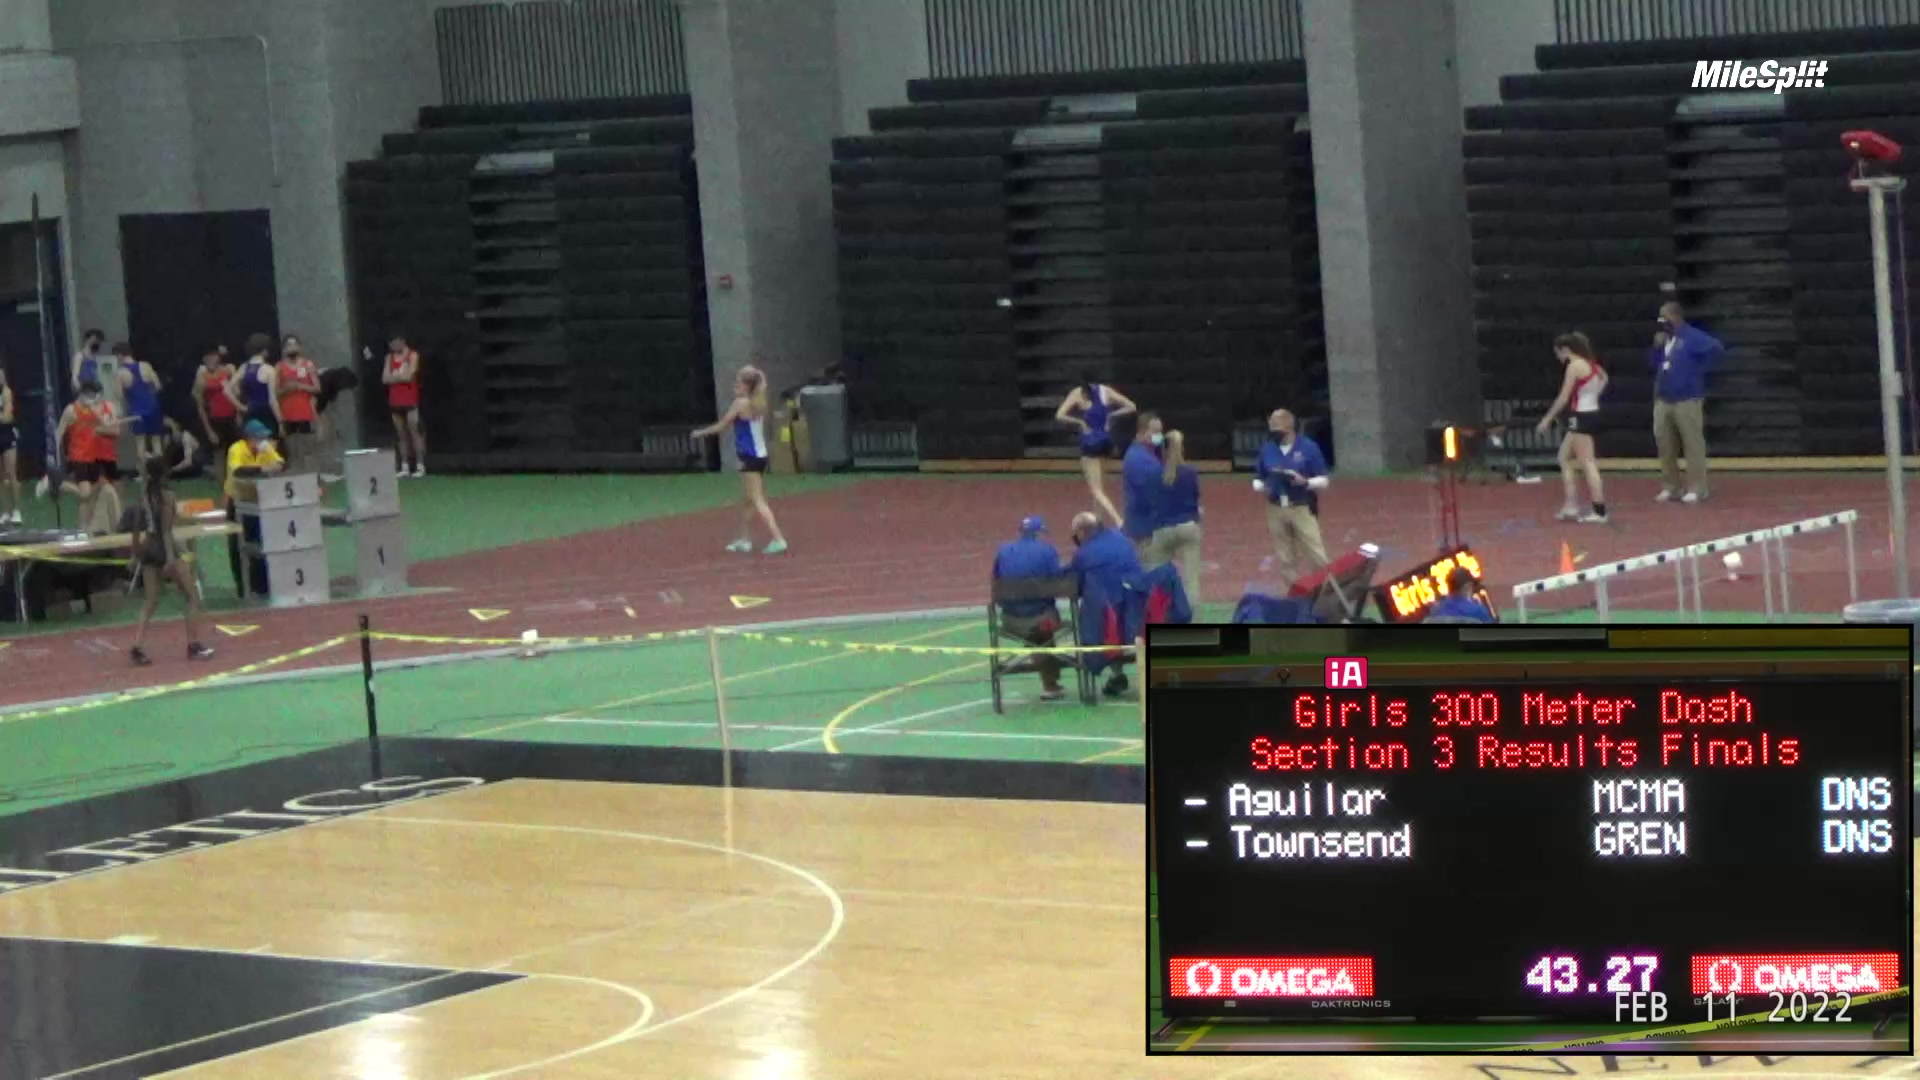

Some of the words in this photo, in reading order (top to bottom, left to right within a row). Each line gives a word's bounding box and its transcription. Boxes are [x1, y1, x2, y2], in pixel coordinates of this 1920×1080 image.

[284, 481, 294, 499] 5
[369, 476, 378, 496] 2
[287, 519, 297, 538] 4
[295, 568, 304, 586] 3
[1295, 693, 1408, 728] Girls
[1432, 693, 1498, 726] 300
[1523, 692, 1637, 725] Meter
[1661, 690, 1753, 724] Dash
[1251, 736, 1409, 770] Section
[1432, 736, 1454, 768] 3
[1478, 735, 1638, 768] Results
[1661, 733, 1799, 766] Finals
[1229, 782, 1387, 817] Aguilar
[1593, 779, 1685, 813] MCMA
[1822, 777, 1892, 811] DNS
[0, 776, 485, 894] LETICS
[1230, 823, 1412, 858] Townsend
[1594, 821, 1686, 855] GREN
[1823, 819, 1892, 853] DNS
[1231, 968, 1355, 995] OMEGA
[1526, 956, 1658, 993] 43.27
[1754, 962, 1880, 991] OMEGA
[1311, 1000, 1391, 1008] DAKTRONICS
[1693, 997, 1741, 1005] GLAY
